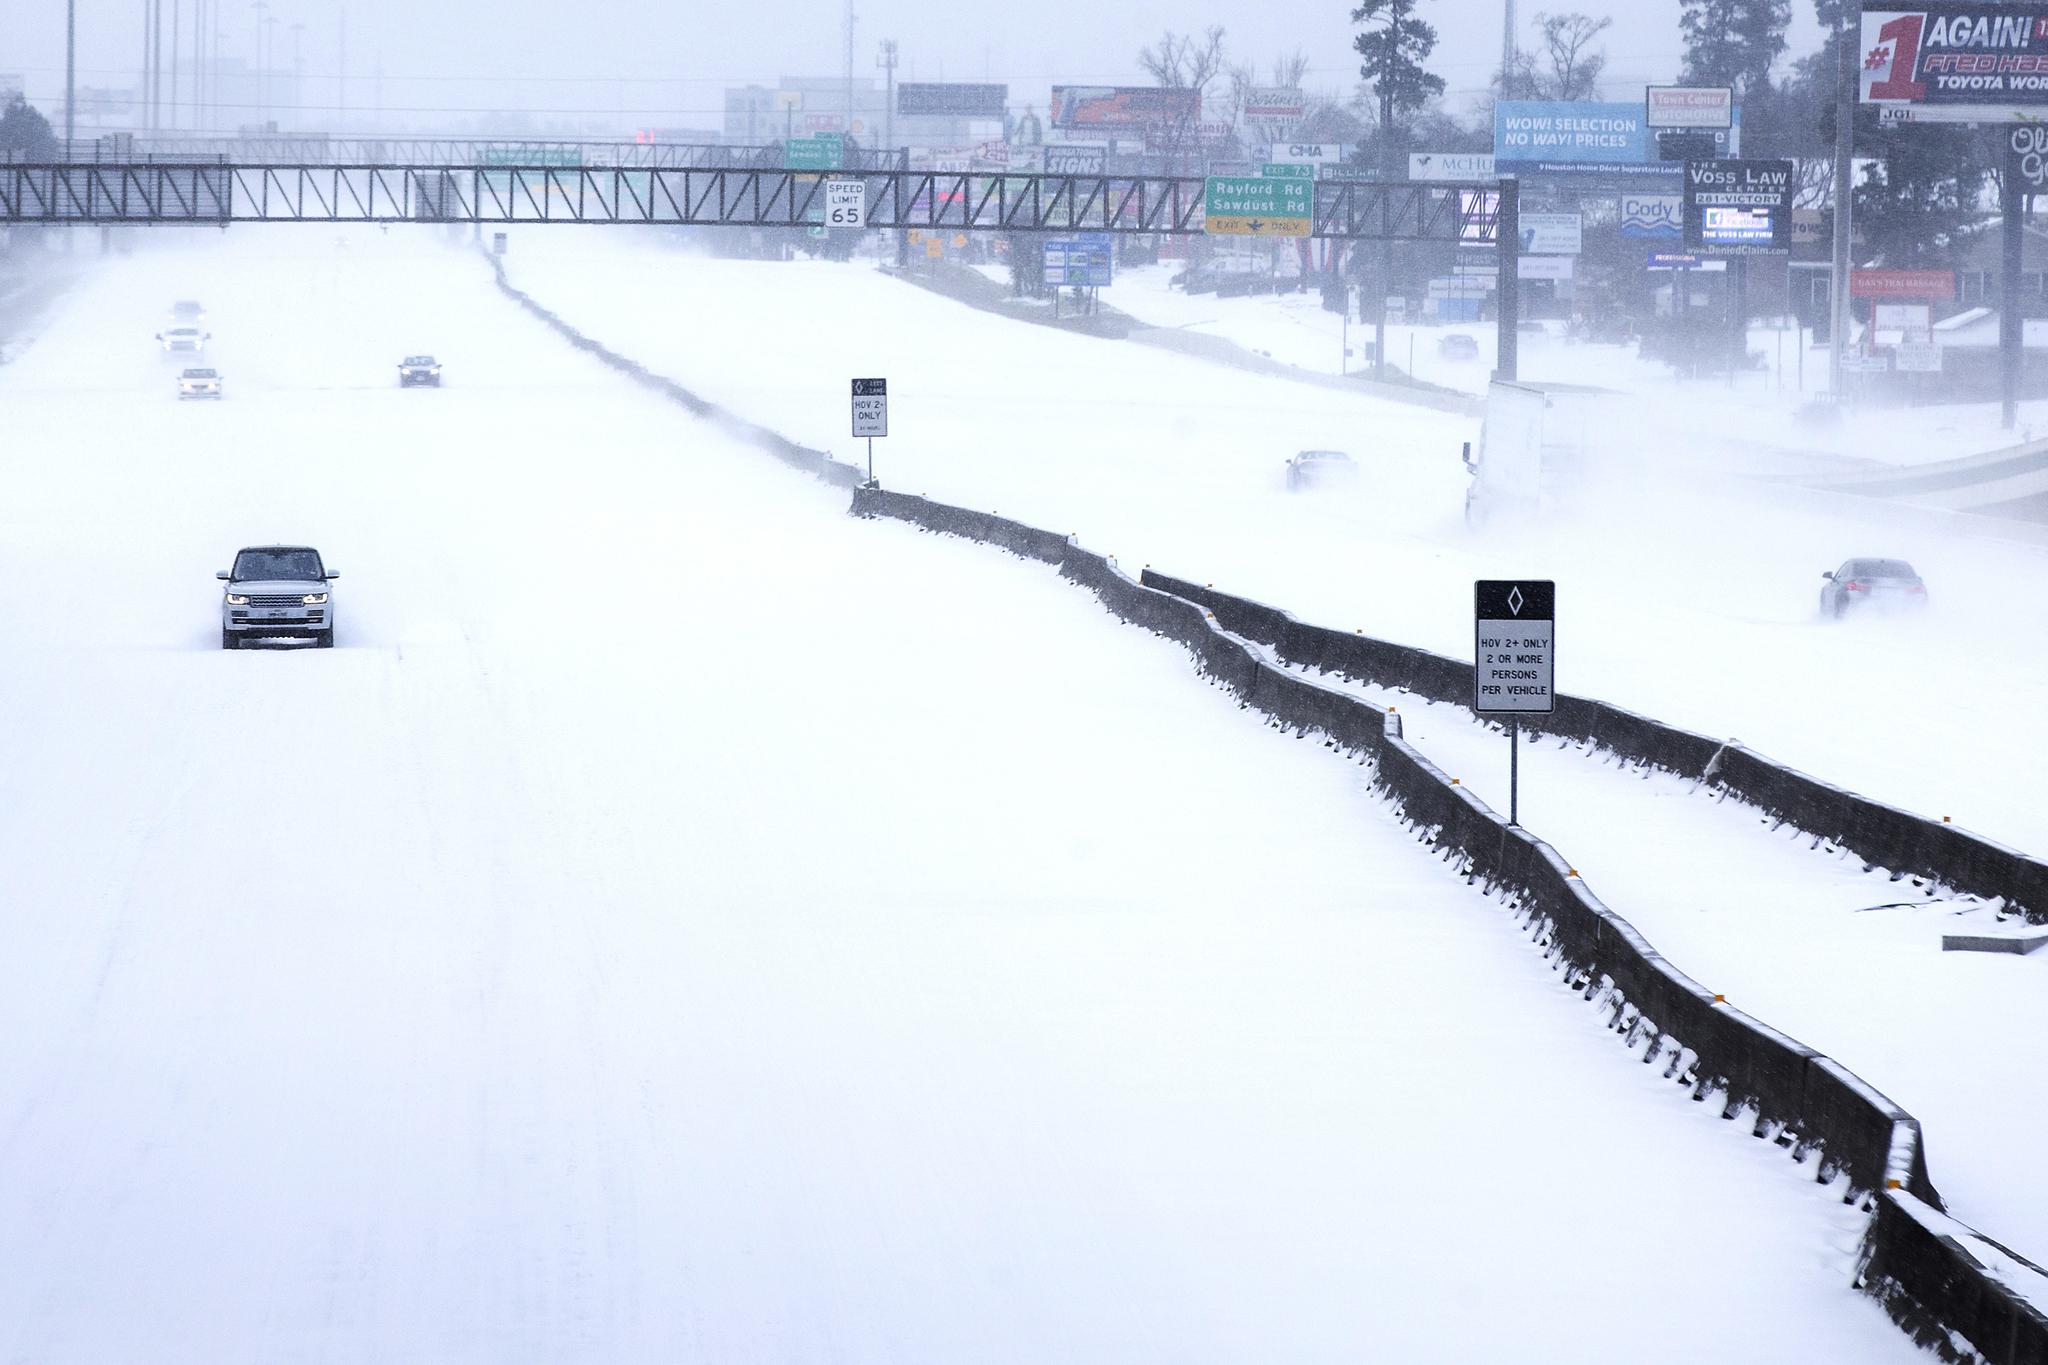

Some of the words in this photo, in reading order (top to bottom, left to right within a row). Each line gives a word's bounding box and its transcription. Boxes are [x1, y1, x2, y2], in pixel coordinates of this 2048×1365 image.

[1926, 16, 2033, 48] AGAIN!
[1937, 76, 2003, 90] TOYOTA
[1658, 94, 1685, 104] Town
[1505, 117, 1551, 131] WOW!
[1555, 118, 1637, 132] SELECTION
[1504, 132, 1529, 146] NO
[1532, 133, 1572, 147] WAY!
[1575, 134, 1628, 148] PRICES
[1047, 157, 1102, 174] SIGNS
[1545, 163, 1576, 171] Houston
[1577, 164, 1598, 172] Home
[1621, 164, 1660, 175] Superstore
[1265, 166, 1286, 175] EXIT
[1294, 166, 1311, 177] 73
[828, 184, 863, 193] SPEED
[1216, 182, 1273, 196] Rayford
[1284, 183, 1303, 195] Rd
[832, 195, 859, 205] LIMIT
[1696, 193, 1780, 204] 281-VICTORY
[1213, 199, 1275, 211] Sawdust
[1287, 200, 1305, 212] Rd
[1626, 200, 1673, 221] Cody
[831, 208, 859, 224] 65
[1216, 221, 1239, 229] EXIT
[1271, 222, 1300, 231] ONLY
[1702, 230, 1717, 238] THE
[1718, 230, 1738, 238] VOSS
[1738, 230, 1754, 239] LAW
[1755, 231, 1773, 239] FIRM
[855, 400, 872, 409] HOV
[858, 411, 881, 420] ONLY
[1481, 638, 1501, 649] HOV
[1505, 638, 1520, 648] 2+
[1523, 638, 1549, 649] ONLY
[1486, 654, 1494, 664] 2
[1498, 654, 1512, 664] OR
[1516, 654, 1544, 664] MORE
[1491, 669, 1538, 680] PERSONS
[1481, 685, 1501, 695] PER
[1506, 685, 1548, 695] VEHICLE
